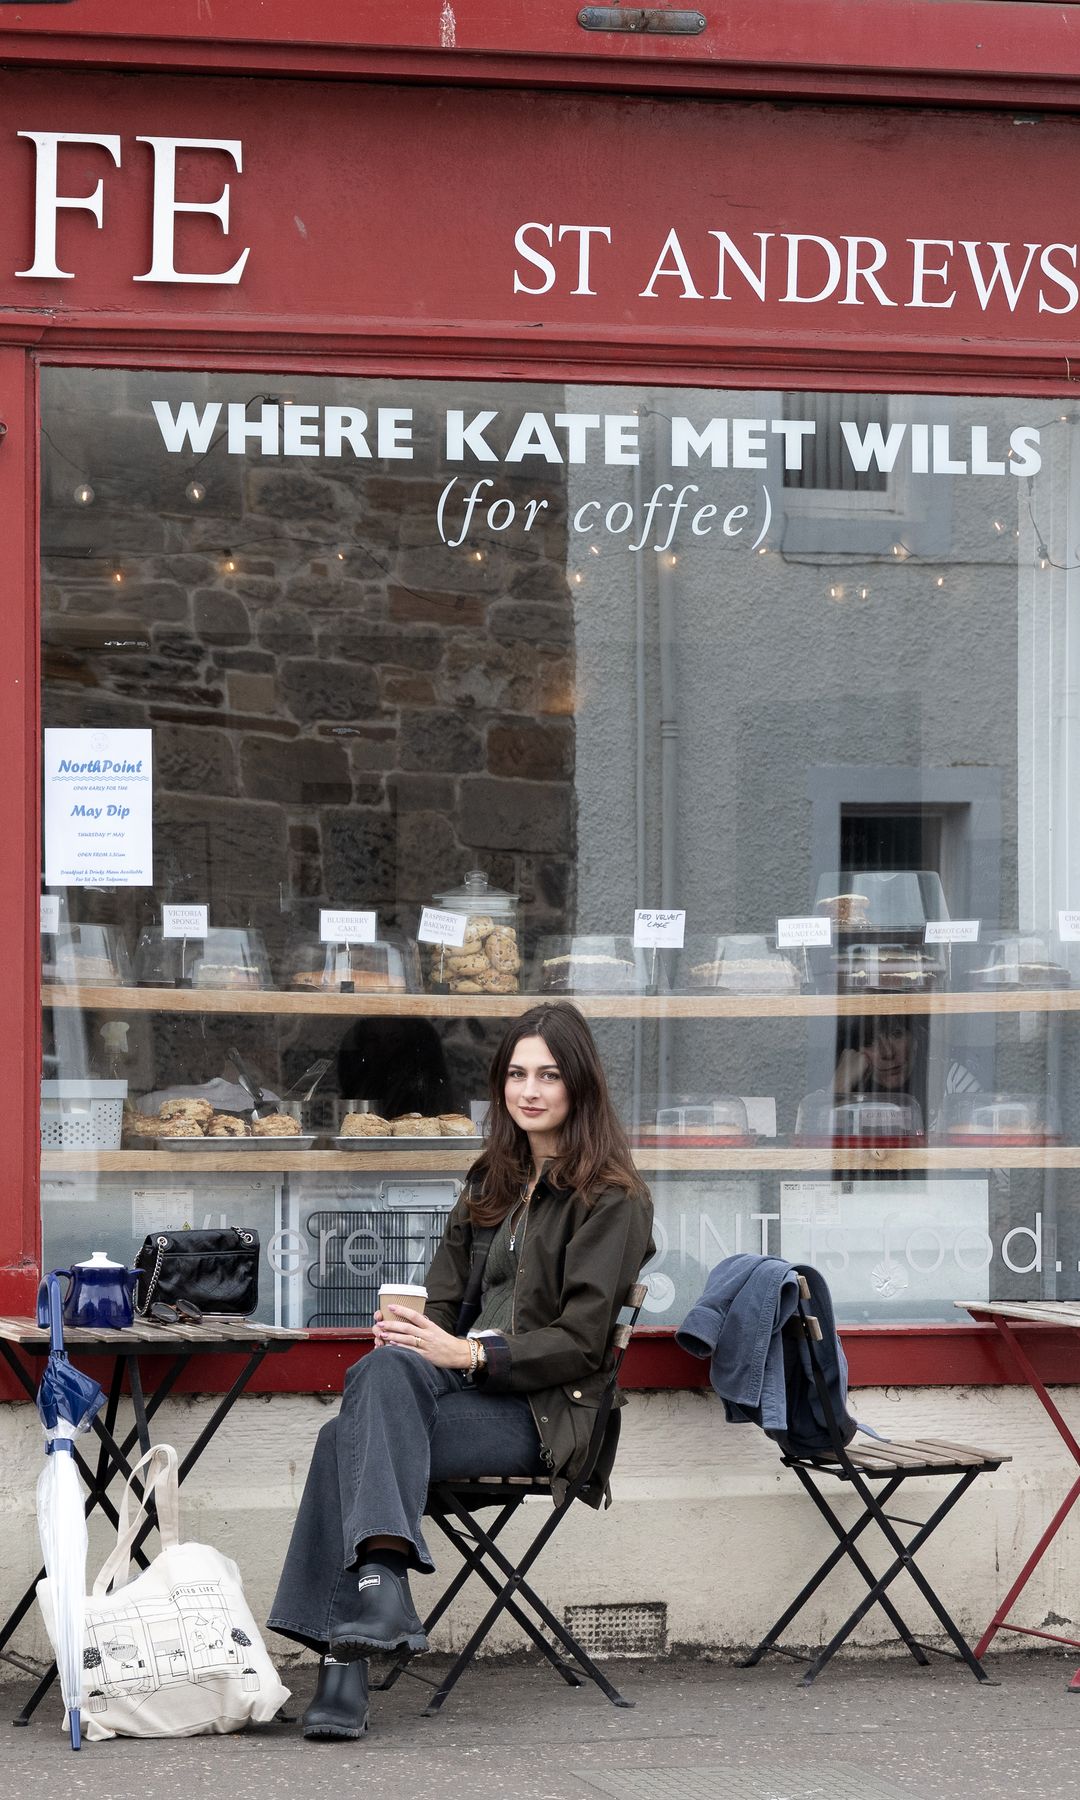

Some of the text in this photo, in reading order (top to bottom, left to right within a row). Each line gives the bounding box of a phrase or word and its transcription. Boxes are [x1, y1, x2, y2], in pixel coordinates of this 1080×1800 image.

[15, 131, 251, 285] FE
[513, 222, 1079, 315] ST ANDREWS
[151, 401, 1042, 477] WHERE KATE MET WILLS
[436, 476, 772, 553] (for coffee)
[58, 760, 142, 773] NorthPoint
[70, 804, 130, 820] May Dip
[168, 909, 202, 917] VICTORIA
[171, 918, 200, 926] SPONGE
